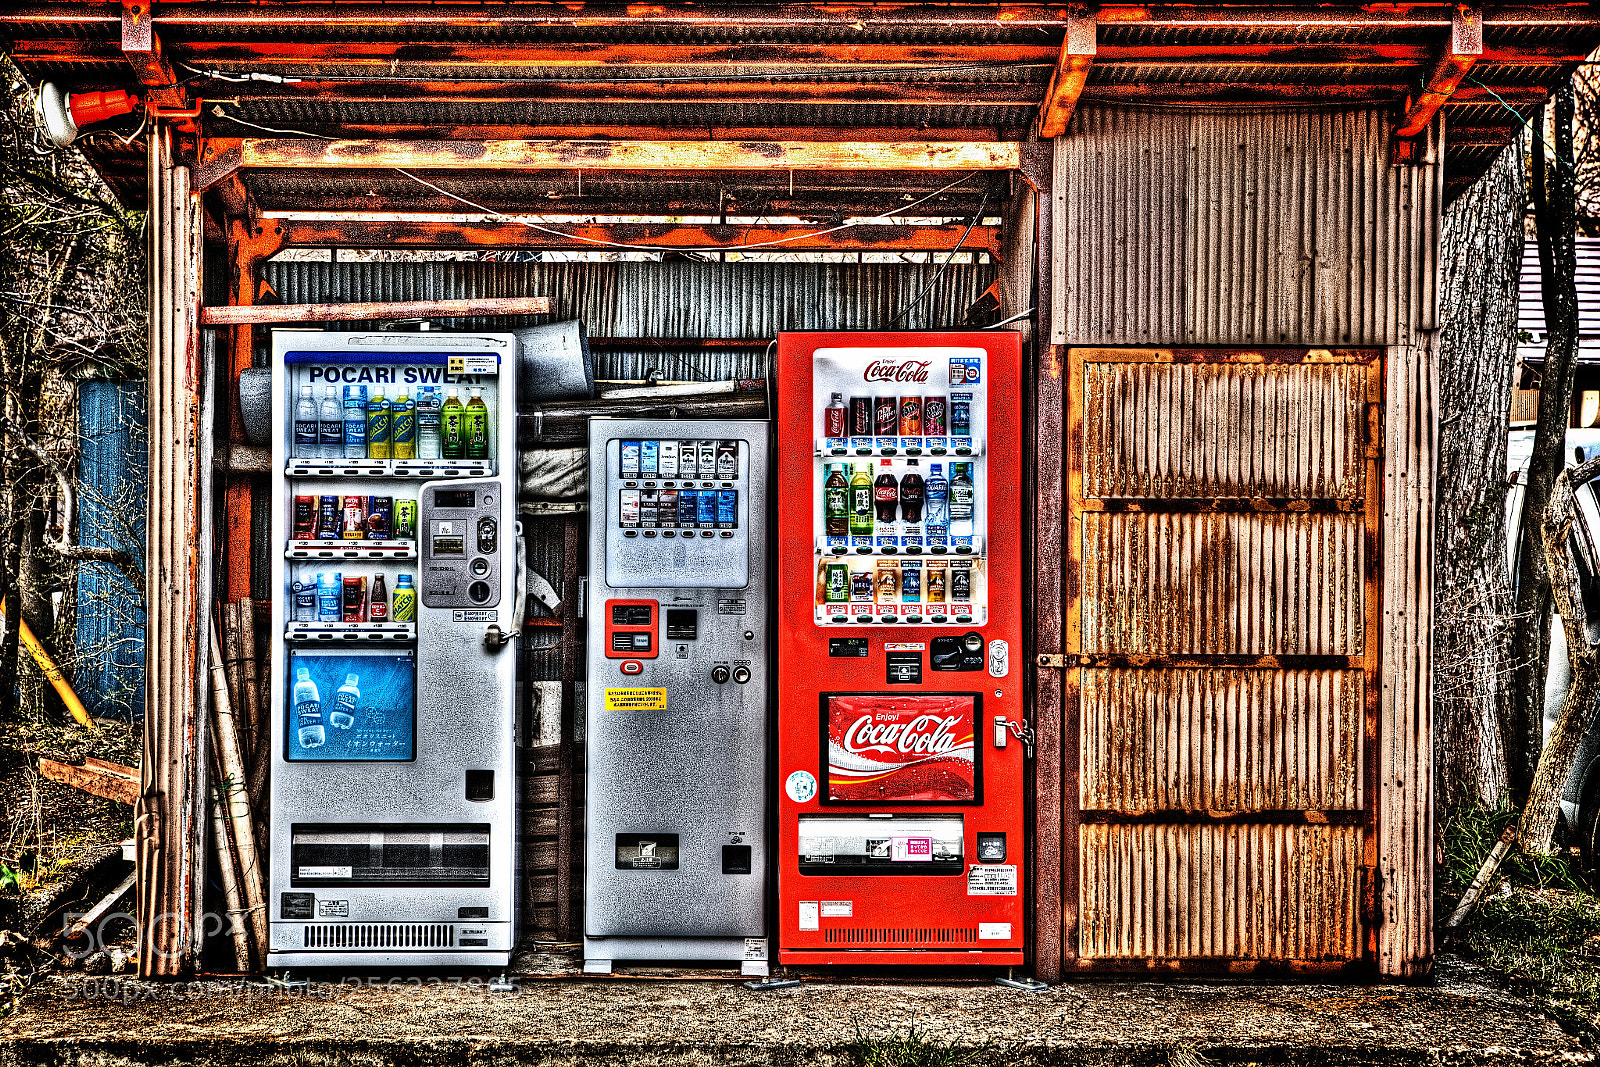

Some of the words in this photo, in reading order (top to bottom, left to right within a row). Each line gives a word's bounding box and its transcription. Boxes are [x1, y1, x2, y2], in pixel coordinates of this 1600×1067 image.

[309, 366, 396, 384] POCARI
[863, 360, 933, 383] Coca-Cola
[875, 487, 897, 499] Coca-Cola
[875, 713, 899, 721] Enjoy!
[843, 713, 964, 755] Coca-Cola
